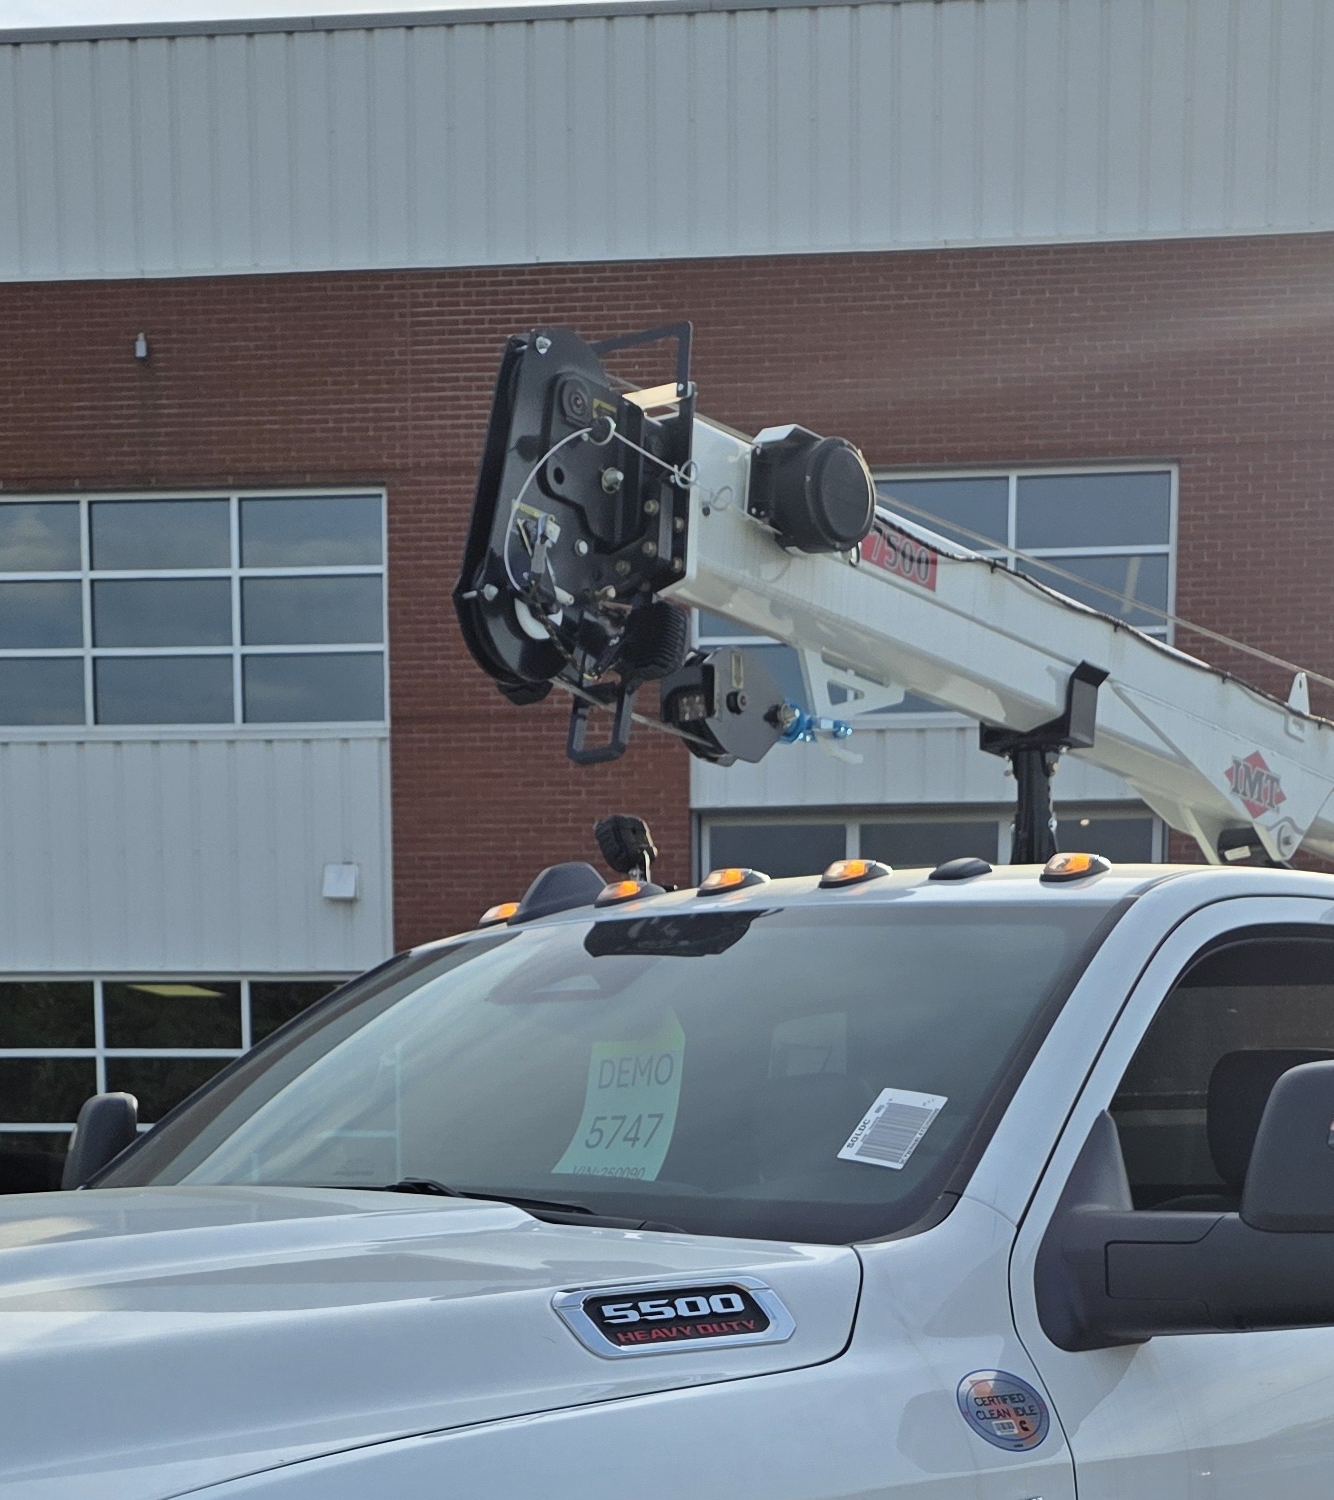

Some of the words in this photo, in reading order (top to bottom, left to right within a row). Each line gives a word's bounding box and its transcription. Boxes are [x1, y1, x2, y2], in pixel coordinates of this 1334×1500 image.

[870, 523, 930, 582] 7500
[1231, 757, 1280, 809] IMT
[598, 1053, 674, 1090] DEMO
[584, 1113, 664, 1150] 5747
[601, 1293, 746, 1324] 5500
[617, 1325, 692, 1344] HEAVY
[696, 1319, 755, 1336] DUTY
[973, 1392, 1026, 1407] CERTIFIED
[975, 1408, 1012, 1421] CLEAN
[1012, 1404, 1038, 1417] IDLE
